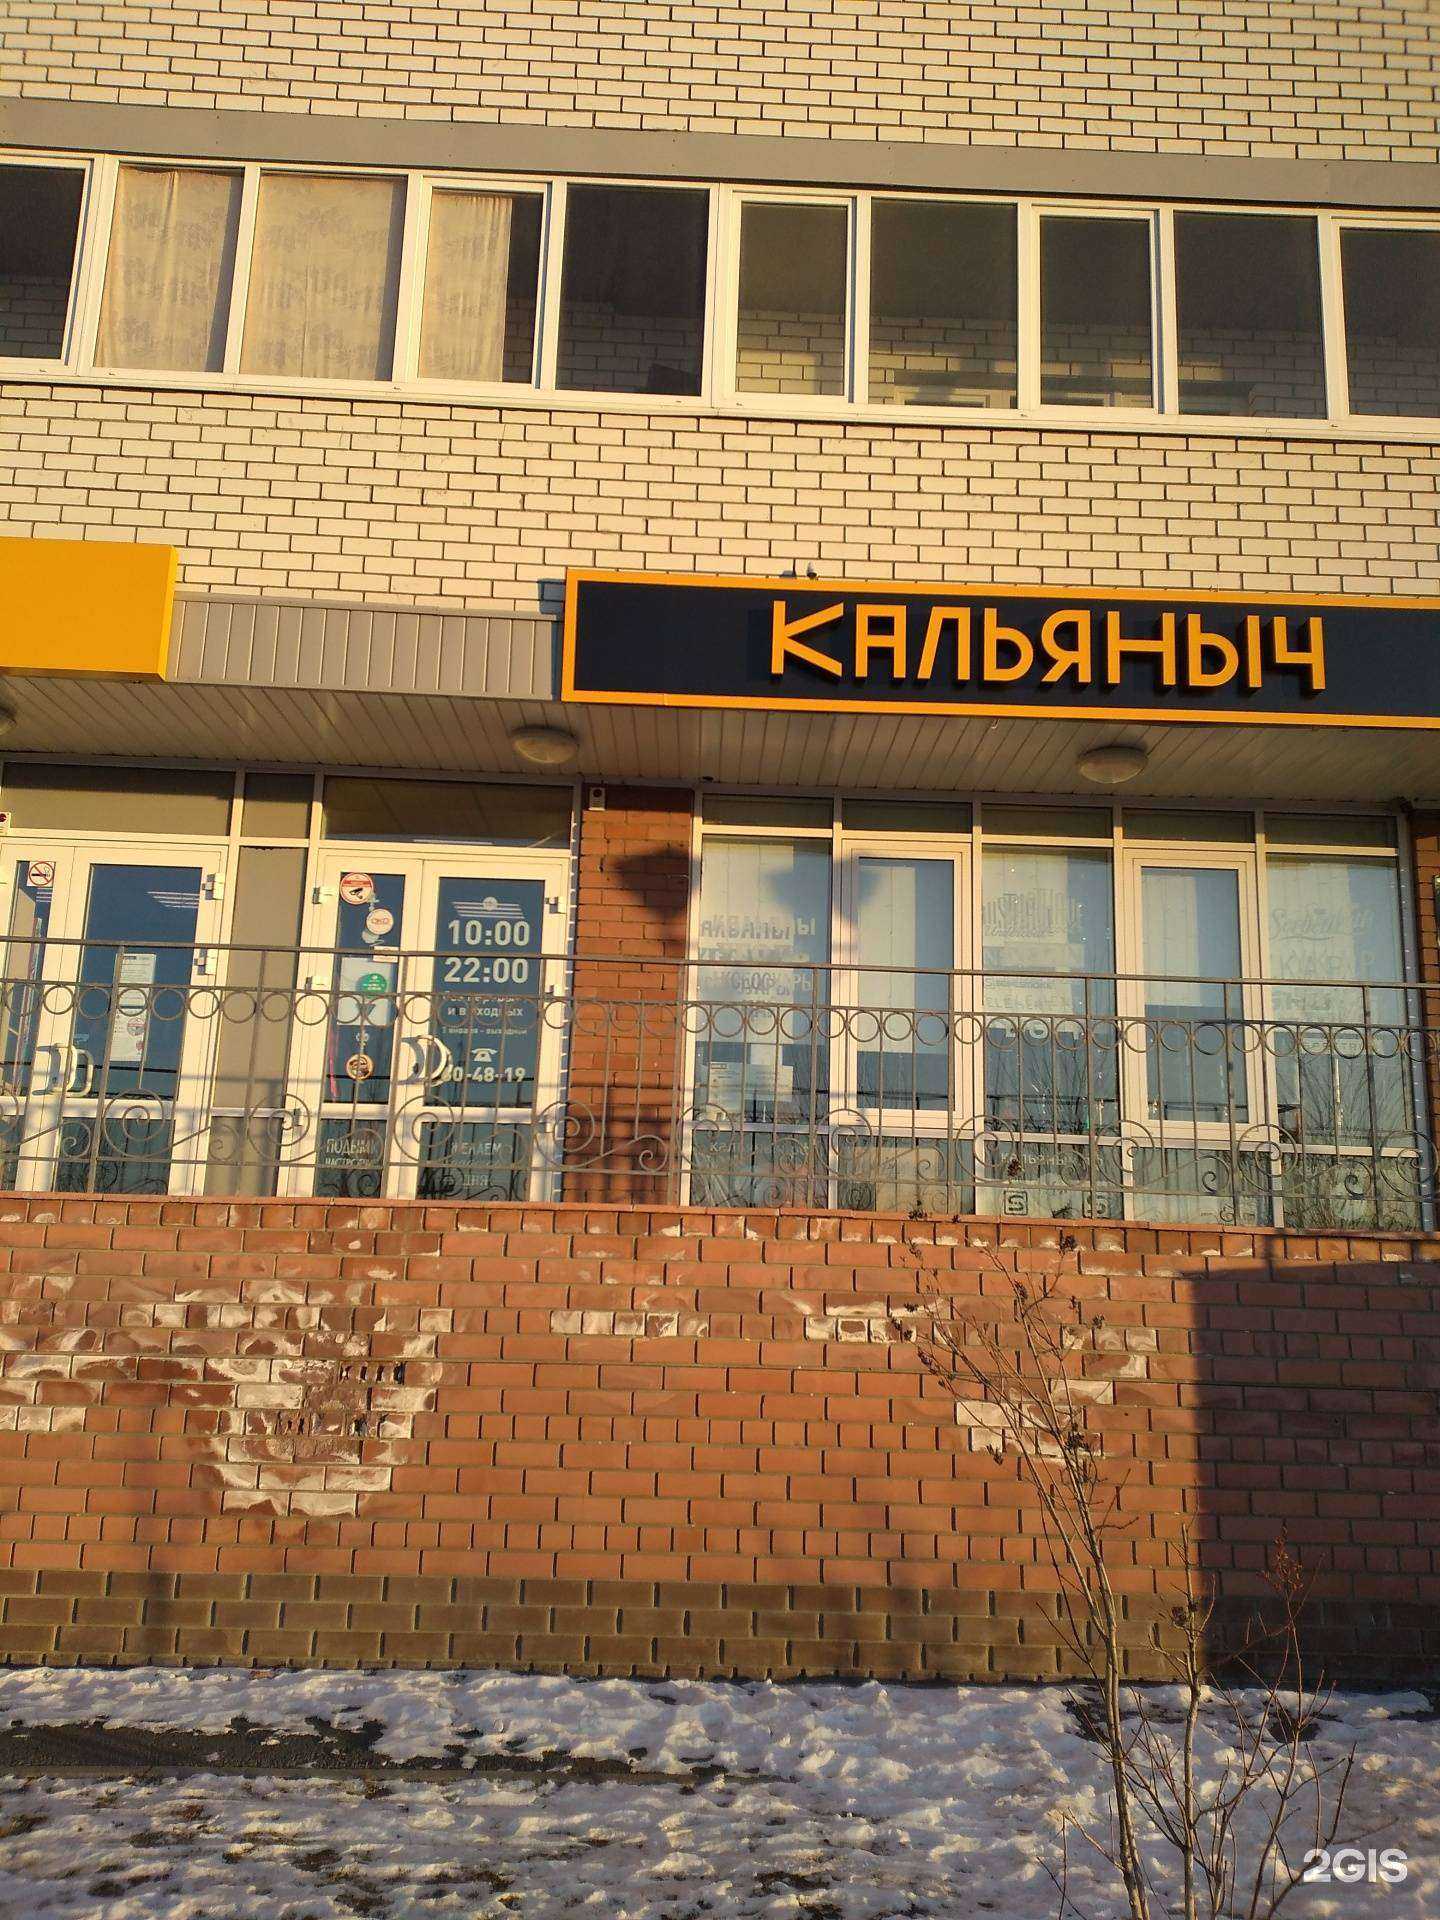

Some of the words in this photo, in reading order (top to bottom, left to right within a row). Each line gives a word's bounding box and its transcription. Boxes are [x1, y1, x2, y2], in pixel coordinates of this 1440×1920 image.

[771, 600, 1325, 689] КАЛЬЯНЫЧ
[448, 919, 530, 946] 10:00
[444, 956, 529, 983] 22:00
